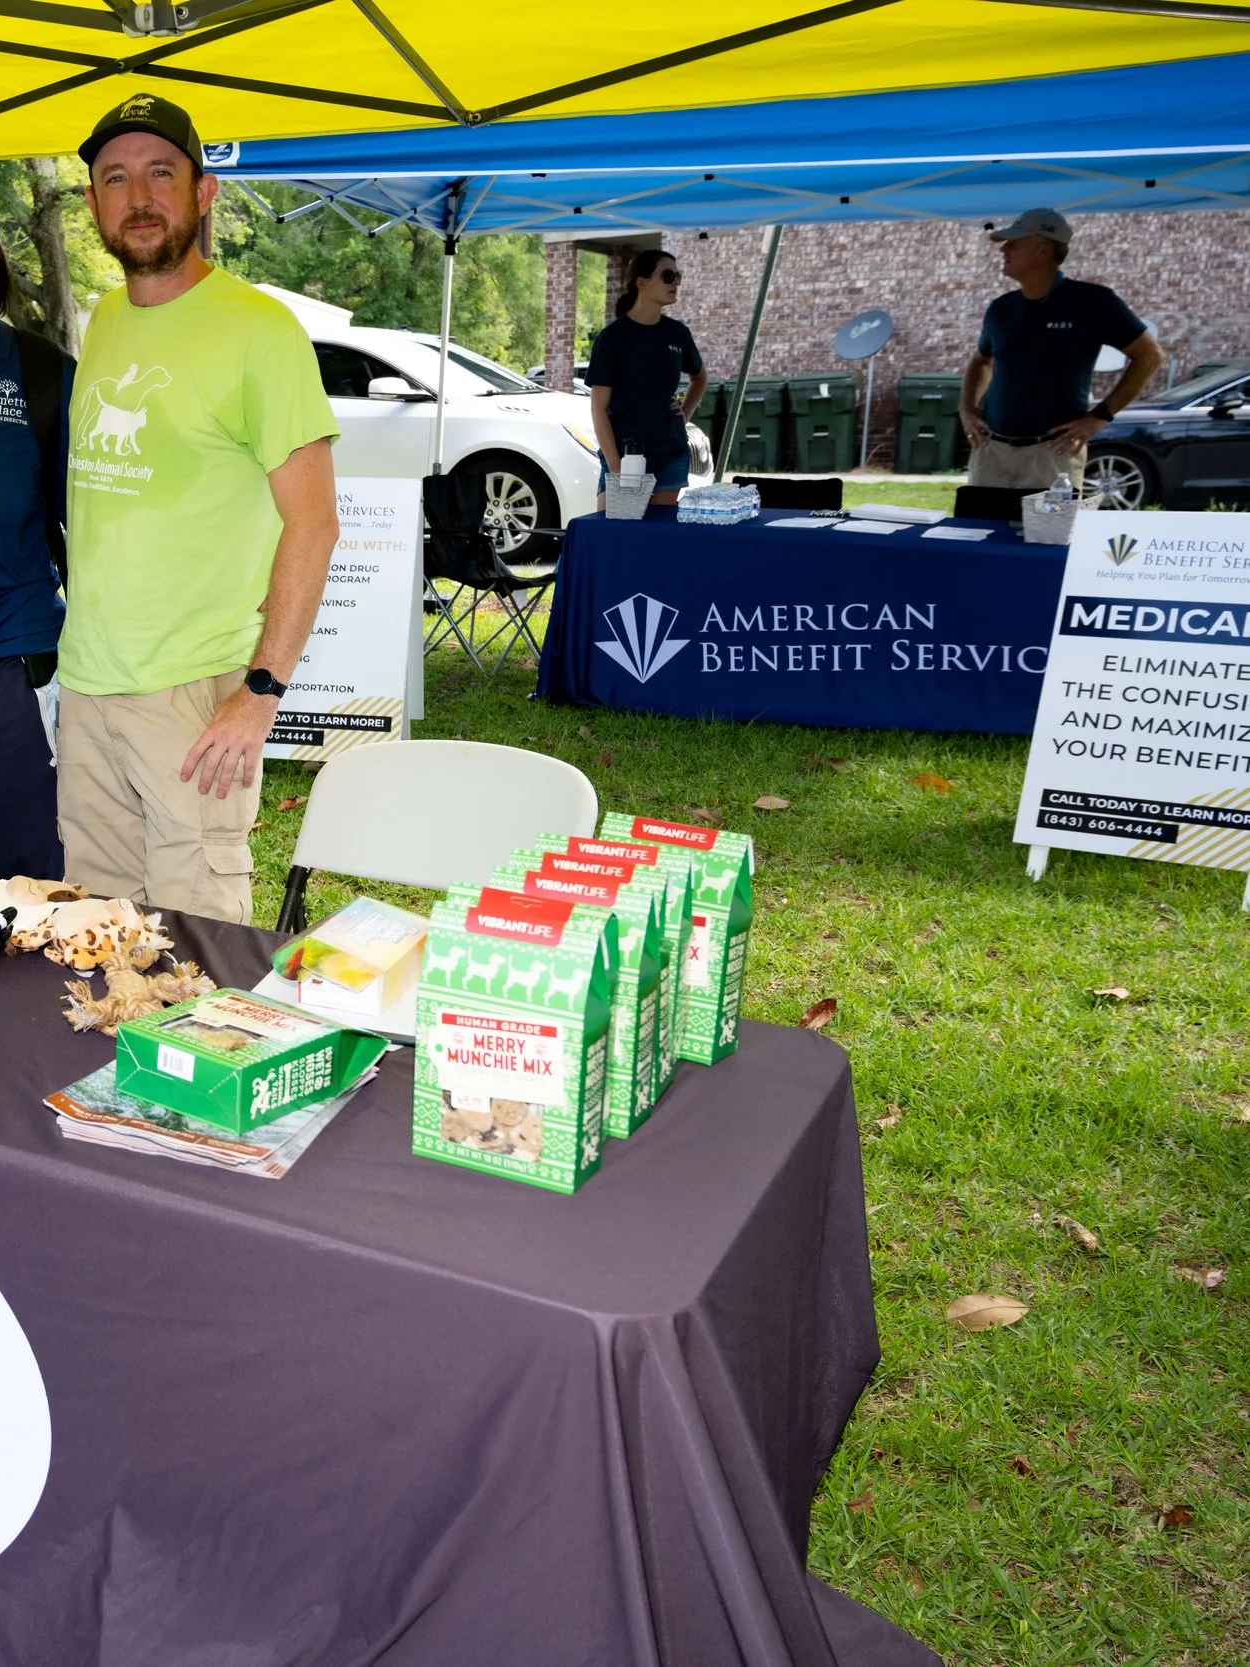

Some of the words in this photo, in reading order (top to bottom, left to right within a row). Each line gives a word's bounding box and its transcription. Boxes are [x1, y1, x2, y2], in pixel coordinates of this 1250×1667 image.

[94, 458, 124, 476] Animal
[123, 462, 154, 482] Society
[338, 505, 396, 517] SERVICES
[338, 540, 358, 551] OU
[363, 540, 408, 552] WITH:
[1146, 538, 1246, 553] AMERICAN
[349, 564, 380, 573] DRUG
[1143, 553, 1217, 568] BENEFIT
[1222, 556, 1250, 569] SER
[326, 575, 371, 584] ROGRAM
[1096, 569, 1135, 581] Helping
[1137, 571, 1157, 581] You
[1158, 572, 1181, 581] Plan
[1183, 573, 1199, 583] for
[320, 599, 357, 608] AVINGS
[698, 601, 937, 633] AMERICAN
[311, 627, 338, 636] LANS
[699, 641, 872, 673] BENEFIT
[891, 639, 1048, 674] SERVIC
[1102, 654, 1250, 682] ELIMINATE
[287, 682, 355, 694] SPORTATION
[1062, 680, 1114, 701] THE
[1122, 686, 1250, 712] CONFUSI
[274, 713, 295, 723] DAY
[296, 714, 311, 724] TO
[312, 715, 348, 726] LEARN
[350, 717, 385, 728] MORE!
[1060, 710, 1122, 731] AND
[268, 731, 314, 742] 06-4444
[1052, 737, 1127, 761] YOUR
[1049, 793, 1085, 807] CALL
[1088, 797, 1138, 813] TODAY
[1140, 802, 1161, 815] TO
[1163, 805, 1214, 821] LEARN
[1217, 811, 1250, 825] MOR
[1043, 813, 1083, 828] (843)
[1088, 818, 1163, 837] 606-4444
[456, 1015, 498, 1030] HUMAN
[500, 1022, 542, 1036] GRADE
[473, 1033, 526, 1055] MERRY
[315, 1049, 325, 1076] WET
[447, 1047, 518, 1071] MUNCHIE
[523, 1057, 553, 1076] MIX
[290, 1059, 300, 1101] KISSES
[298, 1057, 306, 1097] SLOPPY
[304, 1053, 315, 1096] NOSES
